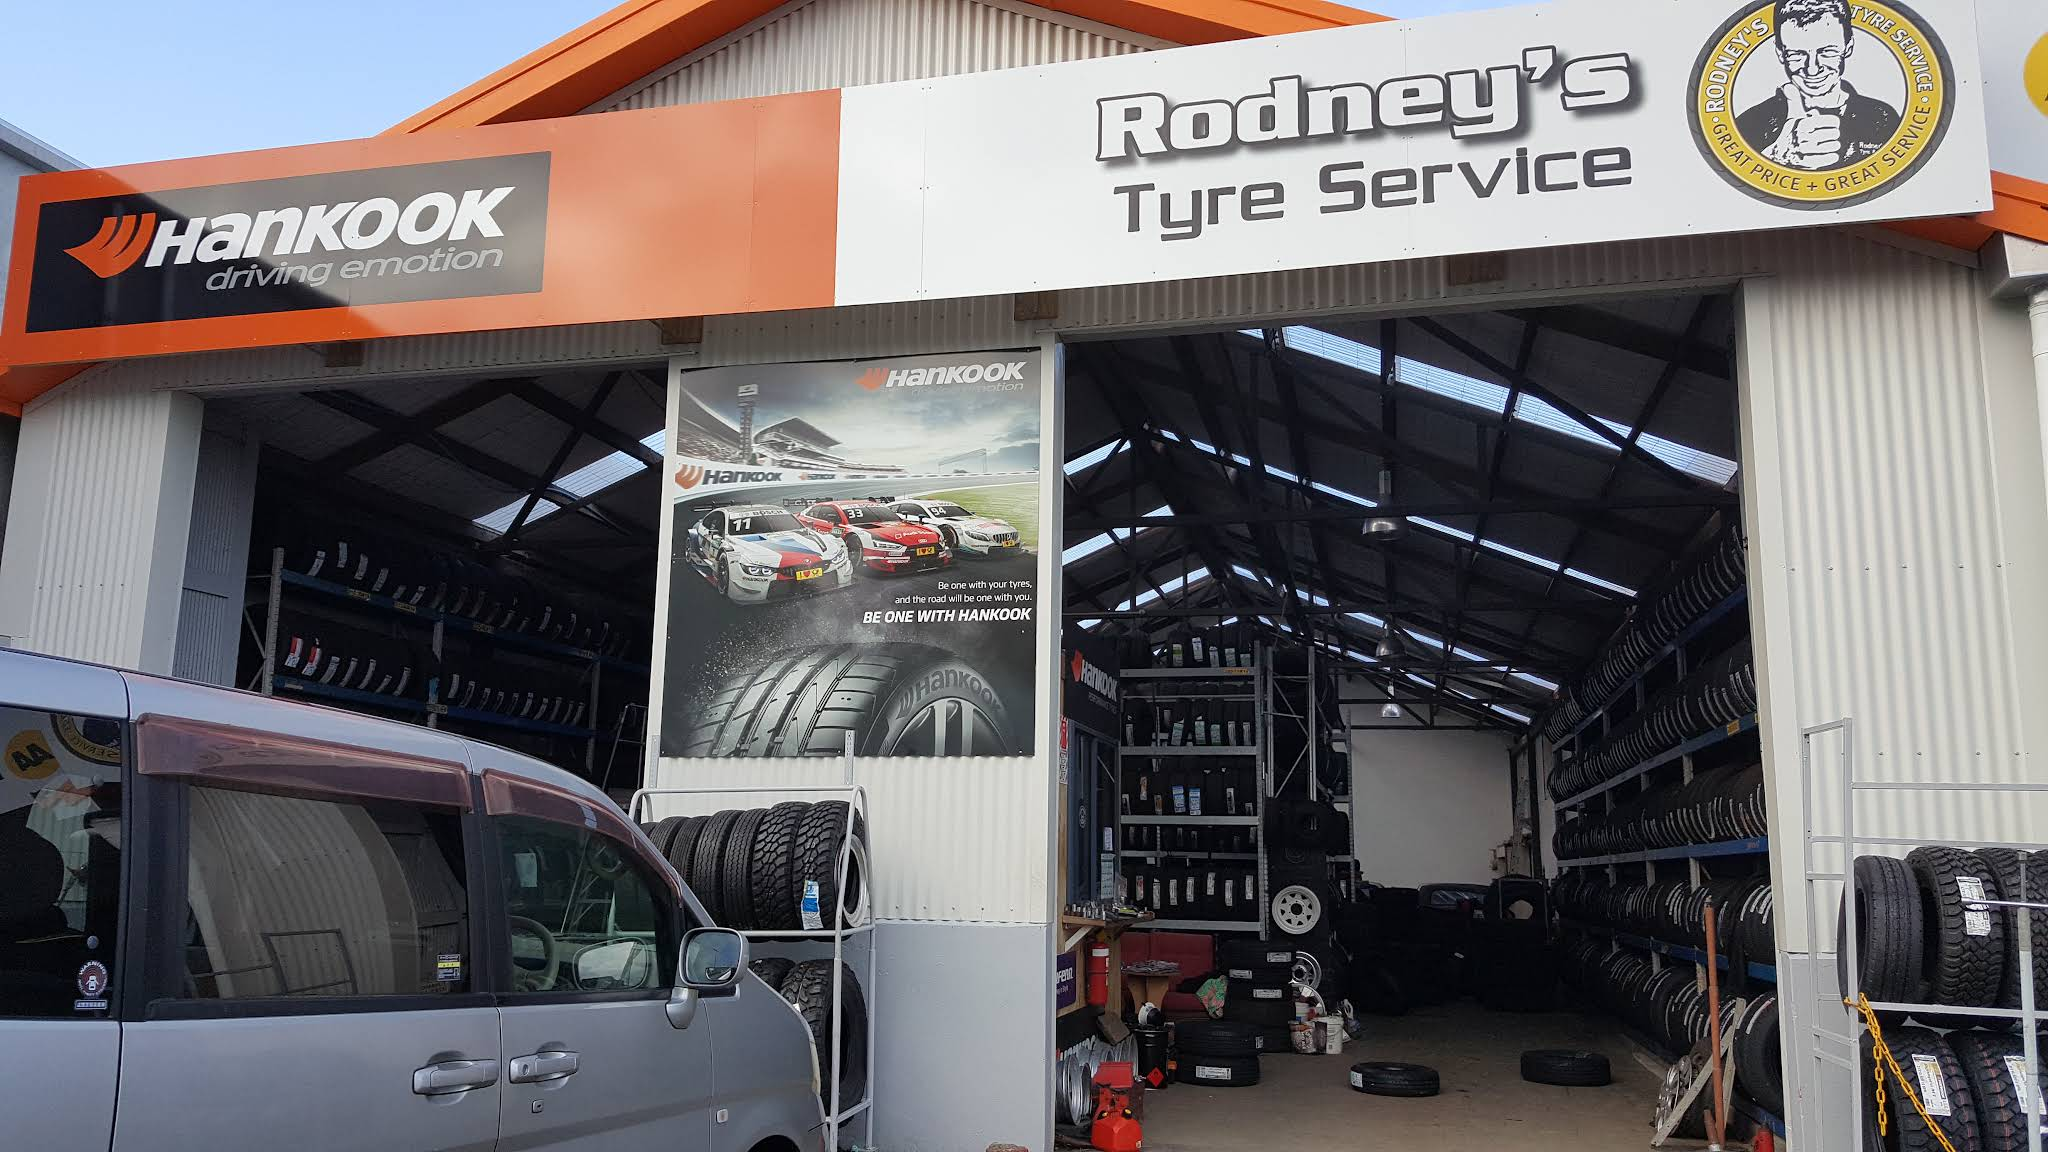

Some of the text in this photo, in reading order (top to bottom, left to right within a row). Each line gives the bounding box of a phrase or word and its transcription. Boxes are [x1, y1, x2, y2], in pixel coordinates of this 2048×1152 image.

[1850, 6, 1934, 93] TYRE SERVICE
[1705, 18, 1769, 113] RODNEY'S
[1096, 45, 1632, 162] Rodney's
[1712, 124, 1752, 167] GREAT
[1750, 163, 1801, 191] PRICE
[1825, 162, 1881, 192] GREAT
[1881, 105, 1932, 167] SERVICE
[1113, 146, 1632, 241] Tyre Service
[145, 186, 516, 268] Hankook
[205, 246, 504, 292] driving emotion
[886, 361, 1027, 388] Hankook
[702, 470, 783, 485] Hankook
[848, 509, 864, 519] 33
[930, 506, 947, 516] 94
[732, 518, 751, 532] 11
[894, 595, 911, 604] and
[912, 595, 926, 604] the
[927, 594, 947, 603] road
[948, 594, 962, 603] will
[963, 594, 975, 603] be
[993, 593, 1013, 602] with
[1014, 594, 1033, 604] you.
[938, 581, 950, 590] Be
[968, 580, 987, 589] with
[988, 581, 1007, 591] your
[1008, 580, 1033, 590] tyres,
[862, 607, 1033, 624] BE ONE WITH HANKOOK
